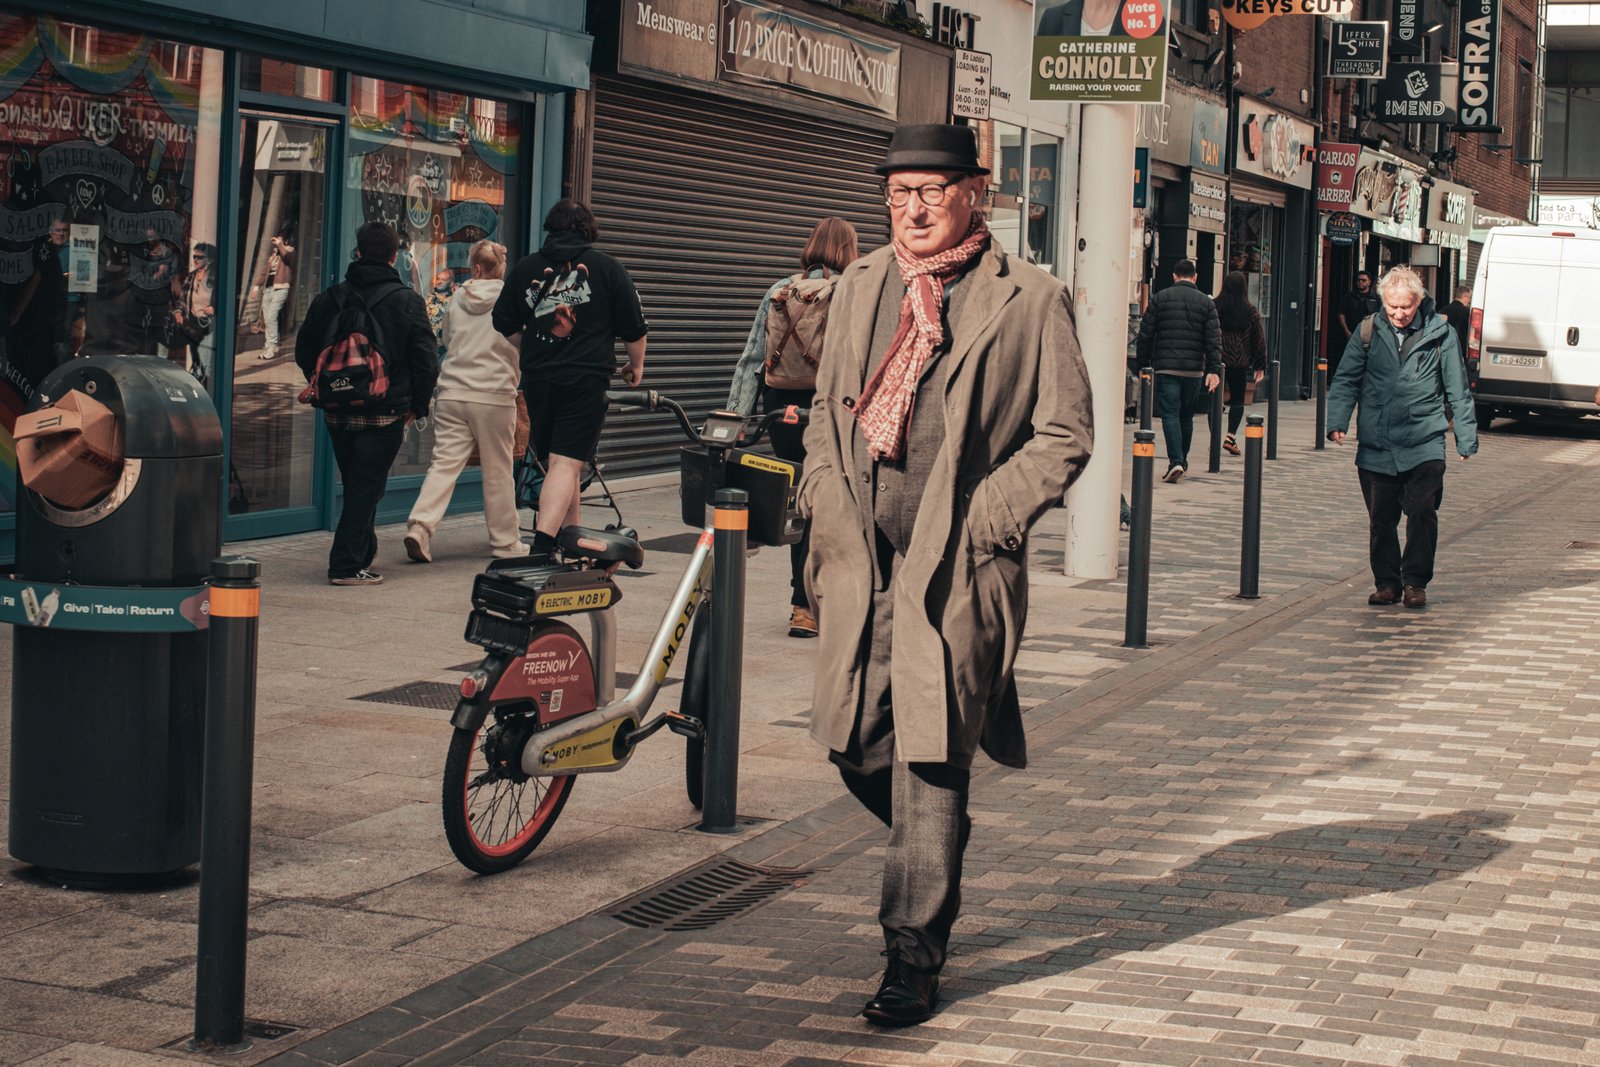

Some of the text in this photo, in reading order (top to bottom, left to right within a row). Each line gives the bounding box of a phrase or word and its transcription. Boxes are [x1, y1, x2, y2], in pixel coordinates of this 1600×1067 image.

[1128, 3, 1156, 14] Vote
[1236, 0, 1342, 14] KEYS CUT
[637, 2, 716, 46] Menswear @
[1128, 14, 1156, 29] No. 1
[1399, 0, 1416, 40] END
[1338, 24, 1371, 45] LIFFEY
[727, 17, 751, 58] 1/2
[754, 23, 795, 69] PRICE
[797, 35, 863, 89] CLOTHING
[1060, 42, 1136, 54] CATHERINE
[1347, 40, 1380, 56] SHINE
[956, 62, 990, 74] LOADING BAY
[1039, 56, 1157, 80] CONNOLLY
[1461, 16, 1491, 126] SOFRA
[1087, 84, 1112, 92] YOUR
[1114, 84, 1141, 92] VOICE
[58, 95, 127, 134] QUEER
[957, 104, 970, 113] MON
[974, 106, 984, 115] SAT
[1200, 138, 1220, 167] TAN
[1320, 150, 1356, 167] CARLOS
[46, 149, 128, 180] BARBER SHOP
[1540, 204, 1554, 212] ted
[546, 592, 606, 608] ELECTRIC MOBY
[64, 602, 174, 616] Give Take Return
[662, 578, 703, 668] MOBY
[522, 658, 568, 675] FREENOW
[528, 678, 536, 686] The
[537, 676, 556, 686] Mobility
